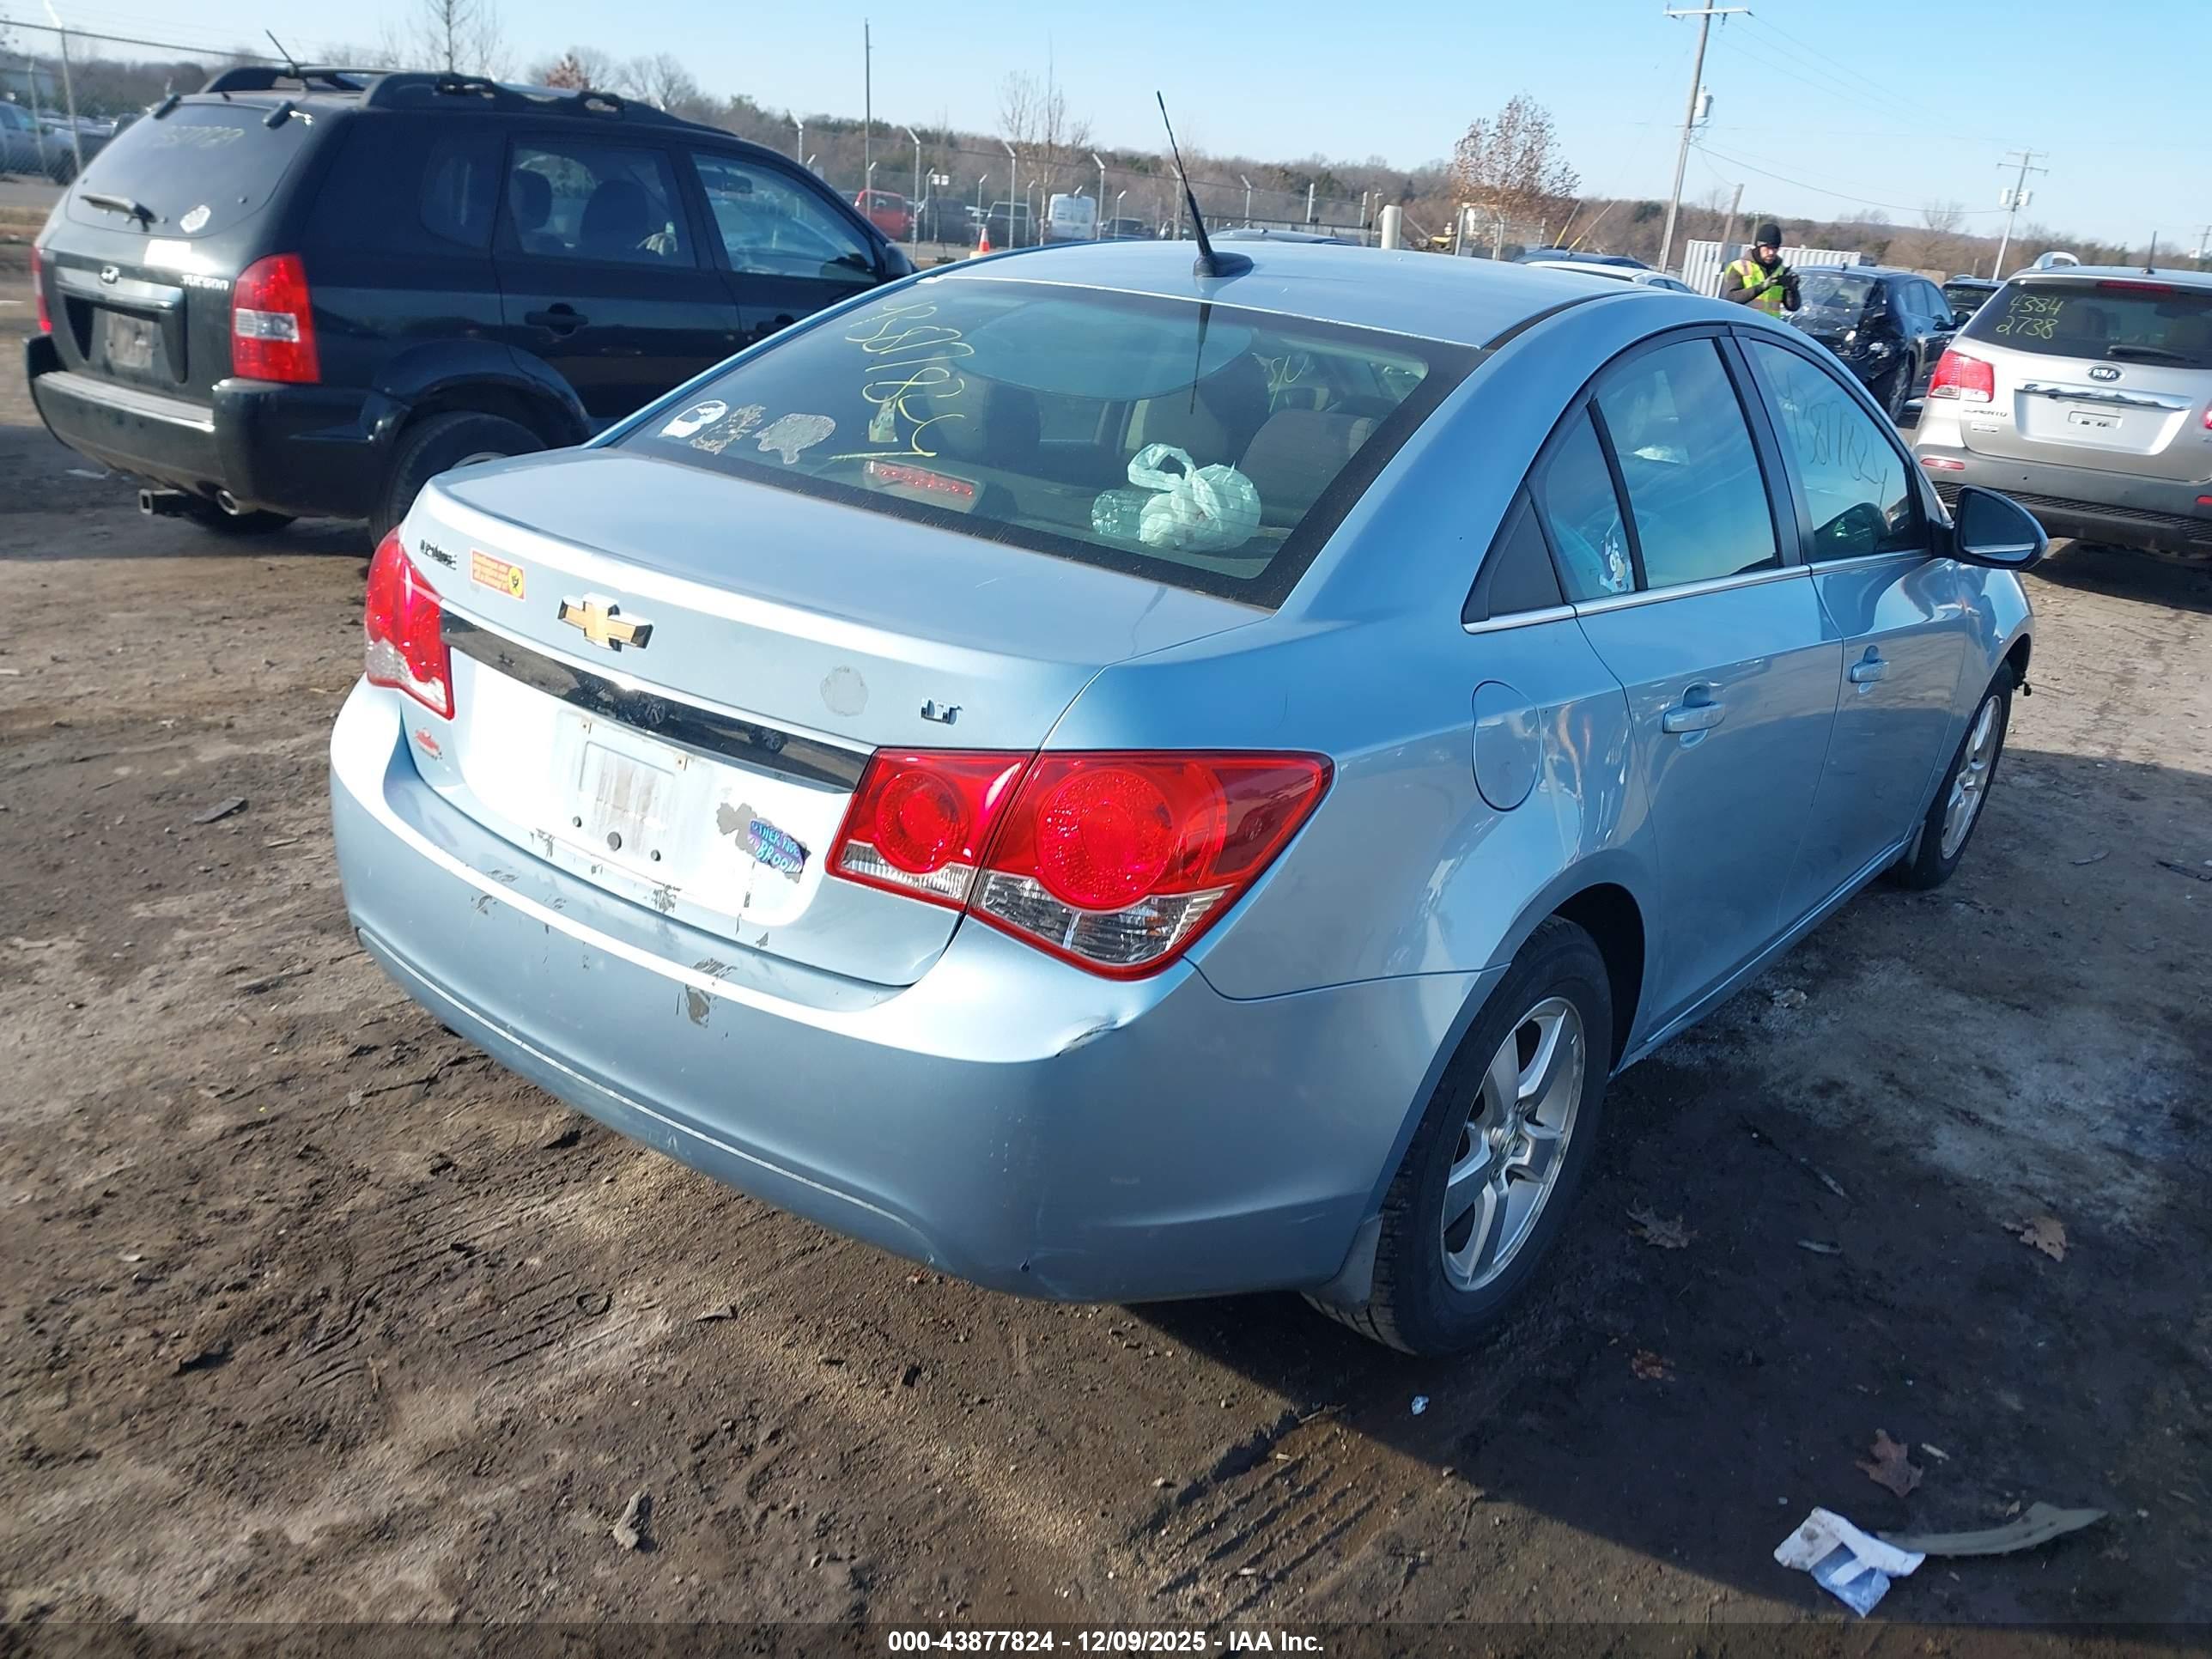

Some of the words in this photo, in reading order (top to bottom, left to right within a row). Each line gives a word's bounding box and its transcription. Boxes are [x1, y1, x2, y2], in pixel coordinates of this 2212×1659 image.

[2008, 294, 2065, 316] 4384
[1995, 314, 2060, 340] 2738
[921, 698, 963, 726] LT
